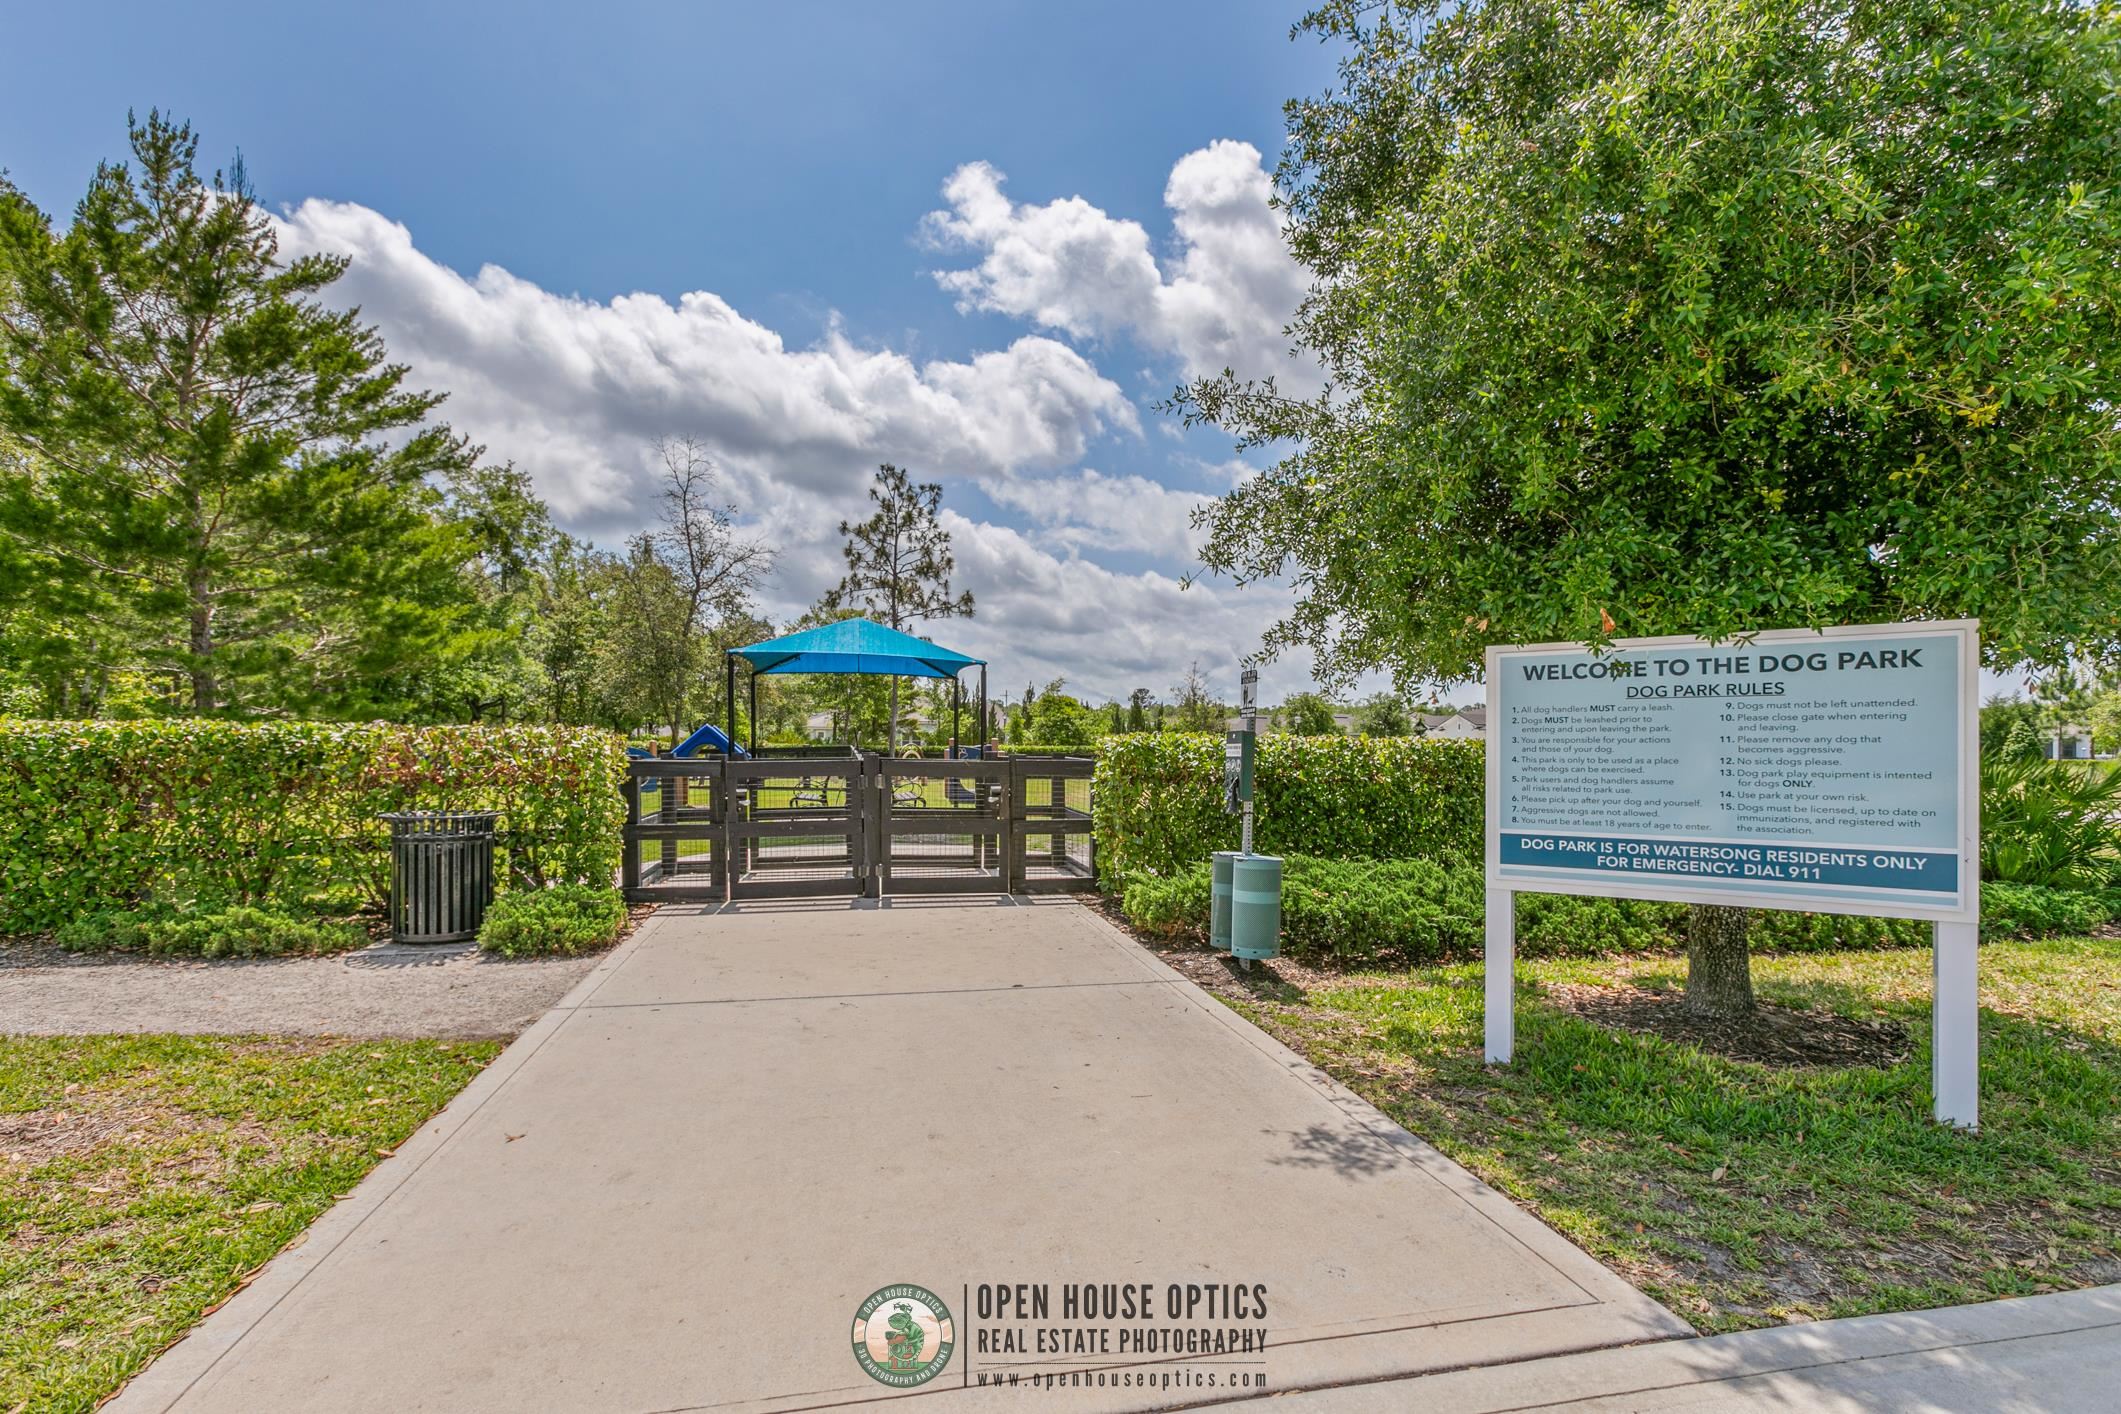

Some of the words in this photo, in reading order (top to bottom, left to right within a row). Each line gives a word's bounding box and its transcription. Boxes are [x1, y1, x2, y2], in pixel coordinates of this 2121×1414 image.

[1653, 658, 1690, 676] TO
[1696, 656, 1750, 675] THE
[1759, 652, 1827, 672] DOG
[1838, 648, 1923, 670] PARK
[1627, 685, 1667, 699] DOG
[1673, 683, 1720, 698] PARK
[1726, 681, 1784, 697] RULES
[1533, 706, 1549, 715] dog
[1552, 705, 1587, 713] handlers
[1589, 704, 1615, 712] MUST
[1617, 705, 1638, 713] carry
[1736, 701, 1764, 711] Dogs
[1813, 700, 1828, 708] be
[1830, 699, 1848, 708] left
[1521, 716, 1542, 726] Dogs
[1584, 715, 1617, 726] leashed
[1619, 717, 1640, 726] prior
[1719, 713, 1735, 721] 10.
[1737, 713, 1769, 721] Please
[1771, 712, 1798, 721] close
[1800, 714, 1824, 722] gate
[1826, 712, 1856, 720] when
[1859, 711, 1907, 721] entering
[1521, 725, 1555, 734] entering
[1599, 724, 1630, 734] leaving
[1632, 724, 1647, 732] the
[1737, 723, 1757, 731] and
[1520, 736, 1536, 744] You
[1552, 735, 1600, 746] responsible
[1602, 735, 1615, 743] for
[1616, 737, 1636, 745] your
[1638, 735, 1671, 743] actions
[1719, 735, 1735, 743] 11.
[1737, 735, 1769, 744] Please
[1813, 737, 1832, 745] any
[1834, 735, 1857, 745] dog
[1859, 735, 1881, 743] that
[1737, 745, 1784, 753] becomes
[1521, 755, 1537, 763] This
[1538, 756, 1557, 766] park
[1567, 756, 1585, 765] only
[1611, 756, 1632, 764] used
[1654, 756, 1679, 766] place
[1737, 757, 1751, 765] No
[1754, 757, 1771, 765] sick
[1775, 757, 1801, 767] dogs
[1547, 765, 1569, 774] dogs
[1719, 768, 1735, 776] 13.
[1736, 768, 1758, 780] Dog
[1761, 769, 1783, 778] park
[1785, 769, 1808, 781] play
[1810, 770, 1870, 781] equipment
[1521, 775, 1537, 783] Park
[1539, 777, 1561, 785] users
[1581, 776, 1598, 785] dog
[1600, 776, 1638, 784] handlers
[1737, 778, 1751, 786] for
[1753, 779, 1779, 789] dogs
[1532, 784, 1550, 792] risks
[1593, 786, 1613, 794] park
[1521, 794, 1547, 802] Please
[1548, 795, 1566, 804] pick
[1580, 796, 1600, 804] after
[1623, 797, 1642, 807] dog
[1643, 798, 1661, 806] and
[1737, 791, 1756, 799] Use
[1758, 791, 1781, 800] park
[1521, 805, 1565, 815] Aggressive
[1567, 807, 1588, 816] dogs
[1719, 802, 1735, 810] 15.
[1737, 802, 1763, 813] Dogs
[1860, 808, 1875, 816] up
[1892, 807, 1918, 816] date
[1582, 818, 1601, 826] least
[1605, 819, 1614, 827] 18
[1654, 823, 1670, 831] age
[1838, 817, 1894, 827] registered
[1897, 819, 1921, 827] with
[1736, 824, 1753, 832] the
[1520, 838, 1554, 850] DOG
[1558, 840, 1597, 852] PARK
[1600, 841, 1613, 853] IS
[1617, 842, 1650, 855] FOR
[1652, 844, 1761, 861] WATERSONG
[1766, 849, 1867, 866] RESIDENTS
[1872, 855, 1927, 870] ONLY
[1596, 855, 1628, 868] FOR
[1632, 857, 1740, 874] EMERGENCY-
[1743, 863, 1785, 877] DIAL
[1788, 866, 1820, 879] 911
